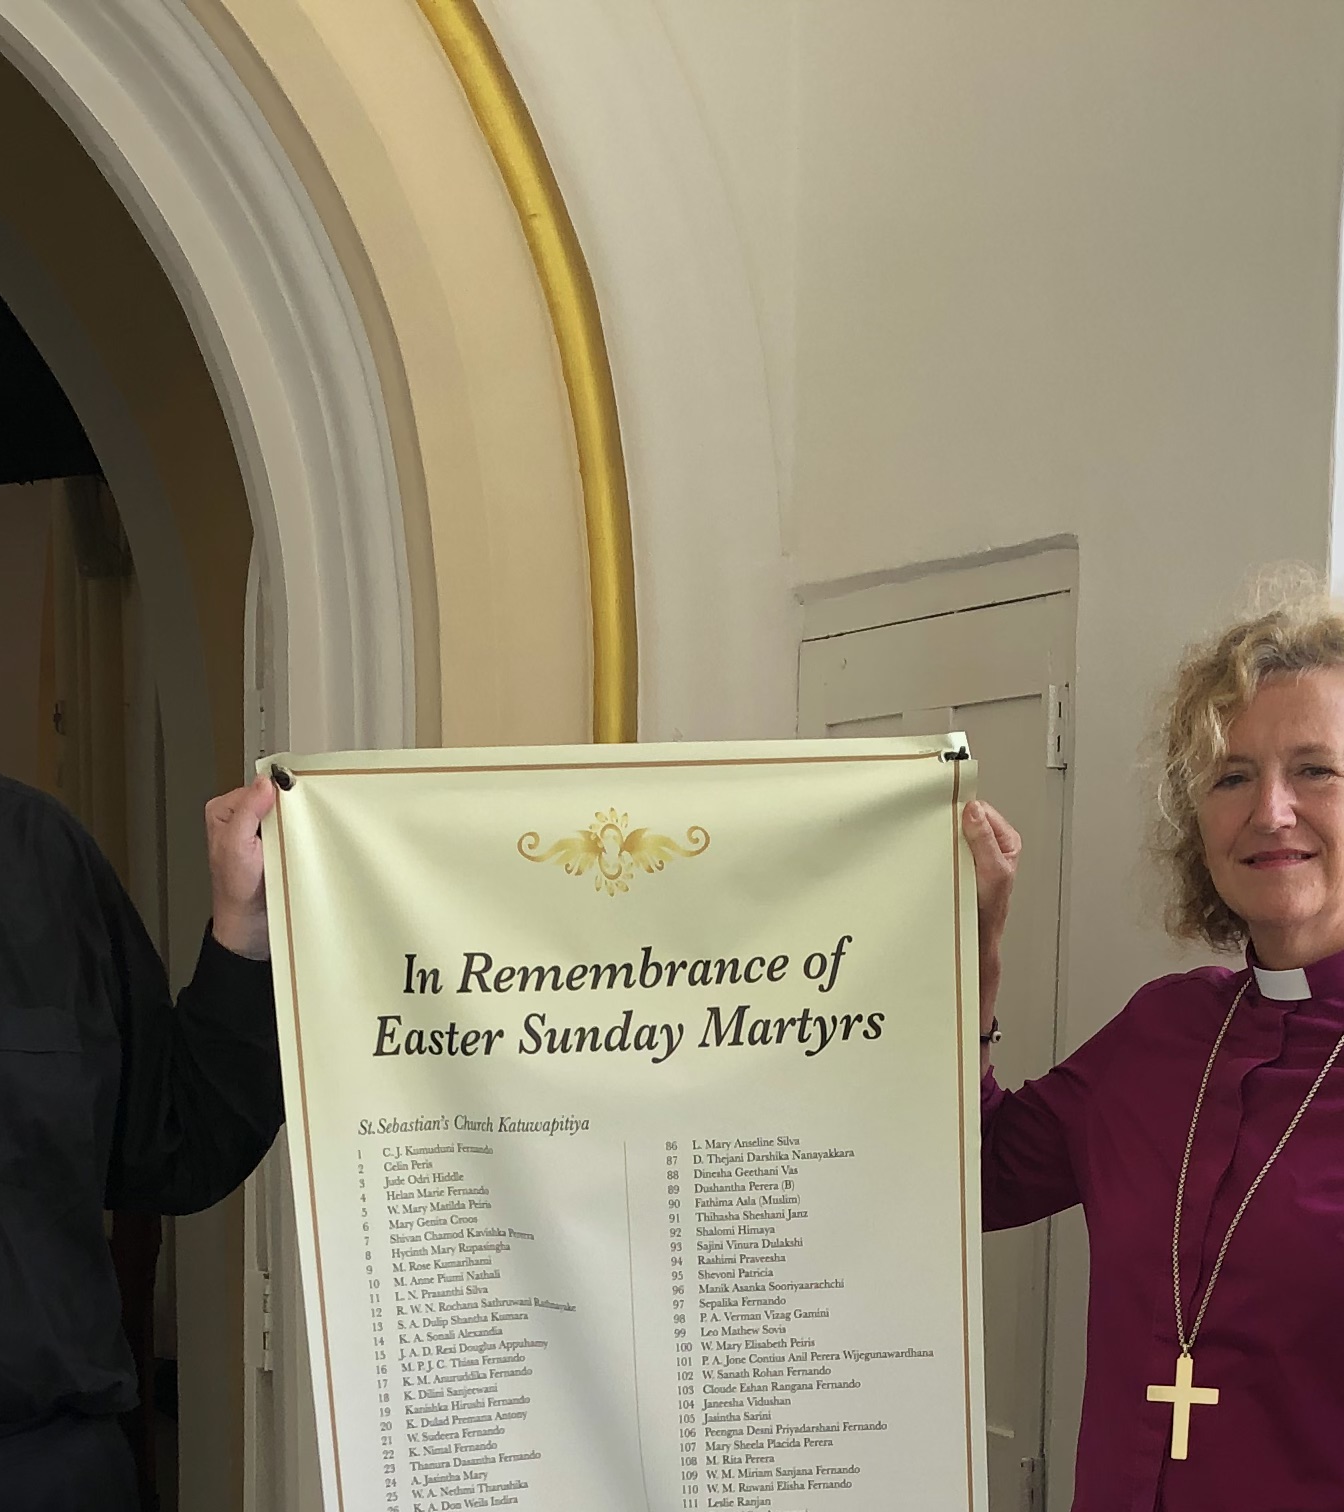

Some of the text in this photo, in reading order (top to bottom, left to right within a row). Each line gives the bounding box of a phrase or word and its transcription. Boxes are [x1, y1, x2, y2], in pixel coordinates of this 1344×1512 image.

[403, 935, 852, 994] In Remembrance of
[372, 1005, 885, 1064] Easter Sunday Martyrs
[454, 1115, 494, 1133] Church
[498, 1115, 590, 1136] Katuwapitiya
[665, 1136, 800, 1150] 86 L. Mary Anseline Silva
[666, 1148, 855, 1166] 87 D. Thejani Darshika Nanayakkara
[358, 1164, 364, 1174] 2
[411, 1160, 433, 1170] Peris
[667, 1165, 798, 1180] 88 Dinesha Geethani Vas
[668, 1180, 795, 1195] 89 Dushantha Perera (B)
[668, 1199, 680, 1209] 90
[695, 1197, 734, 1208] Fathima
[759, 1194, 800, 1207] (Muslim)
[670, 1225, 775, 1238] 92 Shalomi Himaya
[670, 1237, 803, 1253] 93 Sajini Vinura Dulakshi
[671, 1268, 773, 1281] 95 Shevoni Patricia
[672, 1279, 845, 1295] 96 Manik Asanka Sooriyaarachchi
[673, 1296, 786, 1310] 97 Sepalika Fernando
[674, 1314, 686, 1324] 98
[710, 1312, 722, 1322] A.
[724, 1311, 762, 1321] Verman
[764, 1310, 792, 1322] Vizag
[794, 1308, 829, 1319] Gamini
[675, 1337, 815, 1352] 100 W. Mary Elisabeth Peiris
[677, 1365, 832, 1380] 102 W. Sanath Rohan Fernando
[677, 1379, 861, 1395] 103 Cloude Eshan Rangana Fernando
[678, 1395, 791, 1410] 104 Janeesha Vidushan
[679, 1410, 771, 1425] 105 Jasintha Sarini
[381, 1435, 393, 1446] 21
[462, 1425, 505, 1438] Fernando
[680, 1436, 833, 1452] 107 Mary Sheela Placida Perera
[681, 1464, 860, 1480] 109 W. M. Miriam Sanjana Fernando
[682, 1496, 771, 1508] 111 Leslie Ranjan
